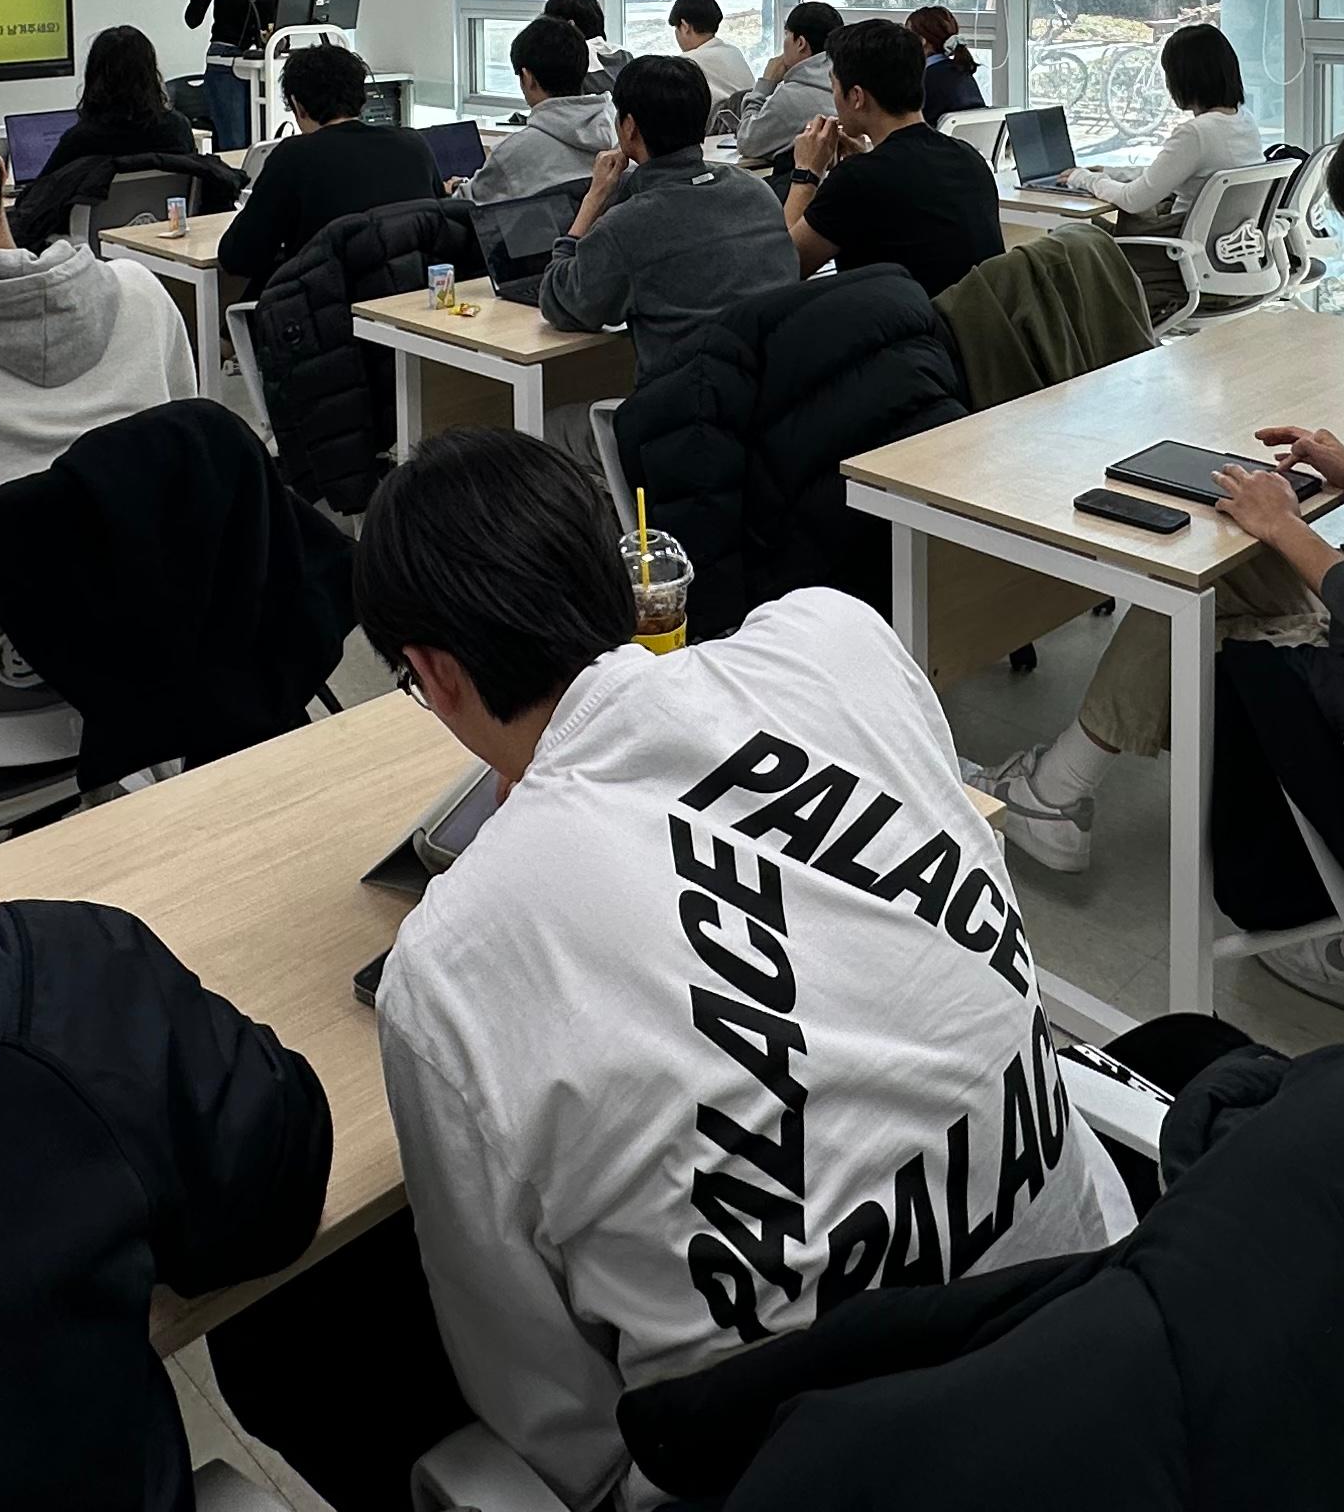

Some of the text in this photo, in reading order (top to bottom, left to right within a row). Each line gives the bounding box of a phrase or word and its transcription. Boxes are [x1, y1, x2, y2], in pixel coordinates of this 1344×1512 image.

[677, 730, 1030, 999] PALACE
[668, 813, 807, 1344] PALACE
[810, 1004, 1070, 1326] PALAC
